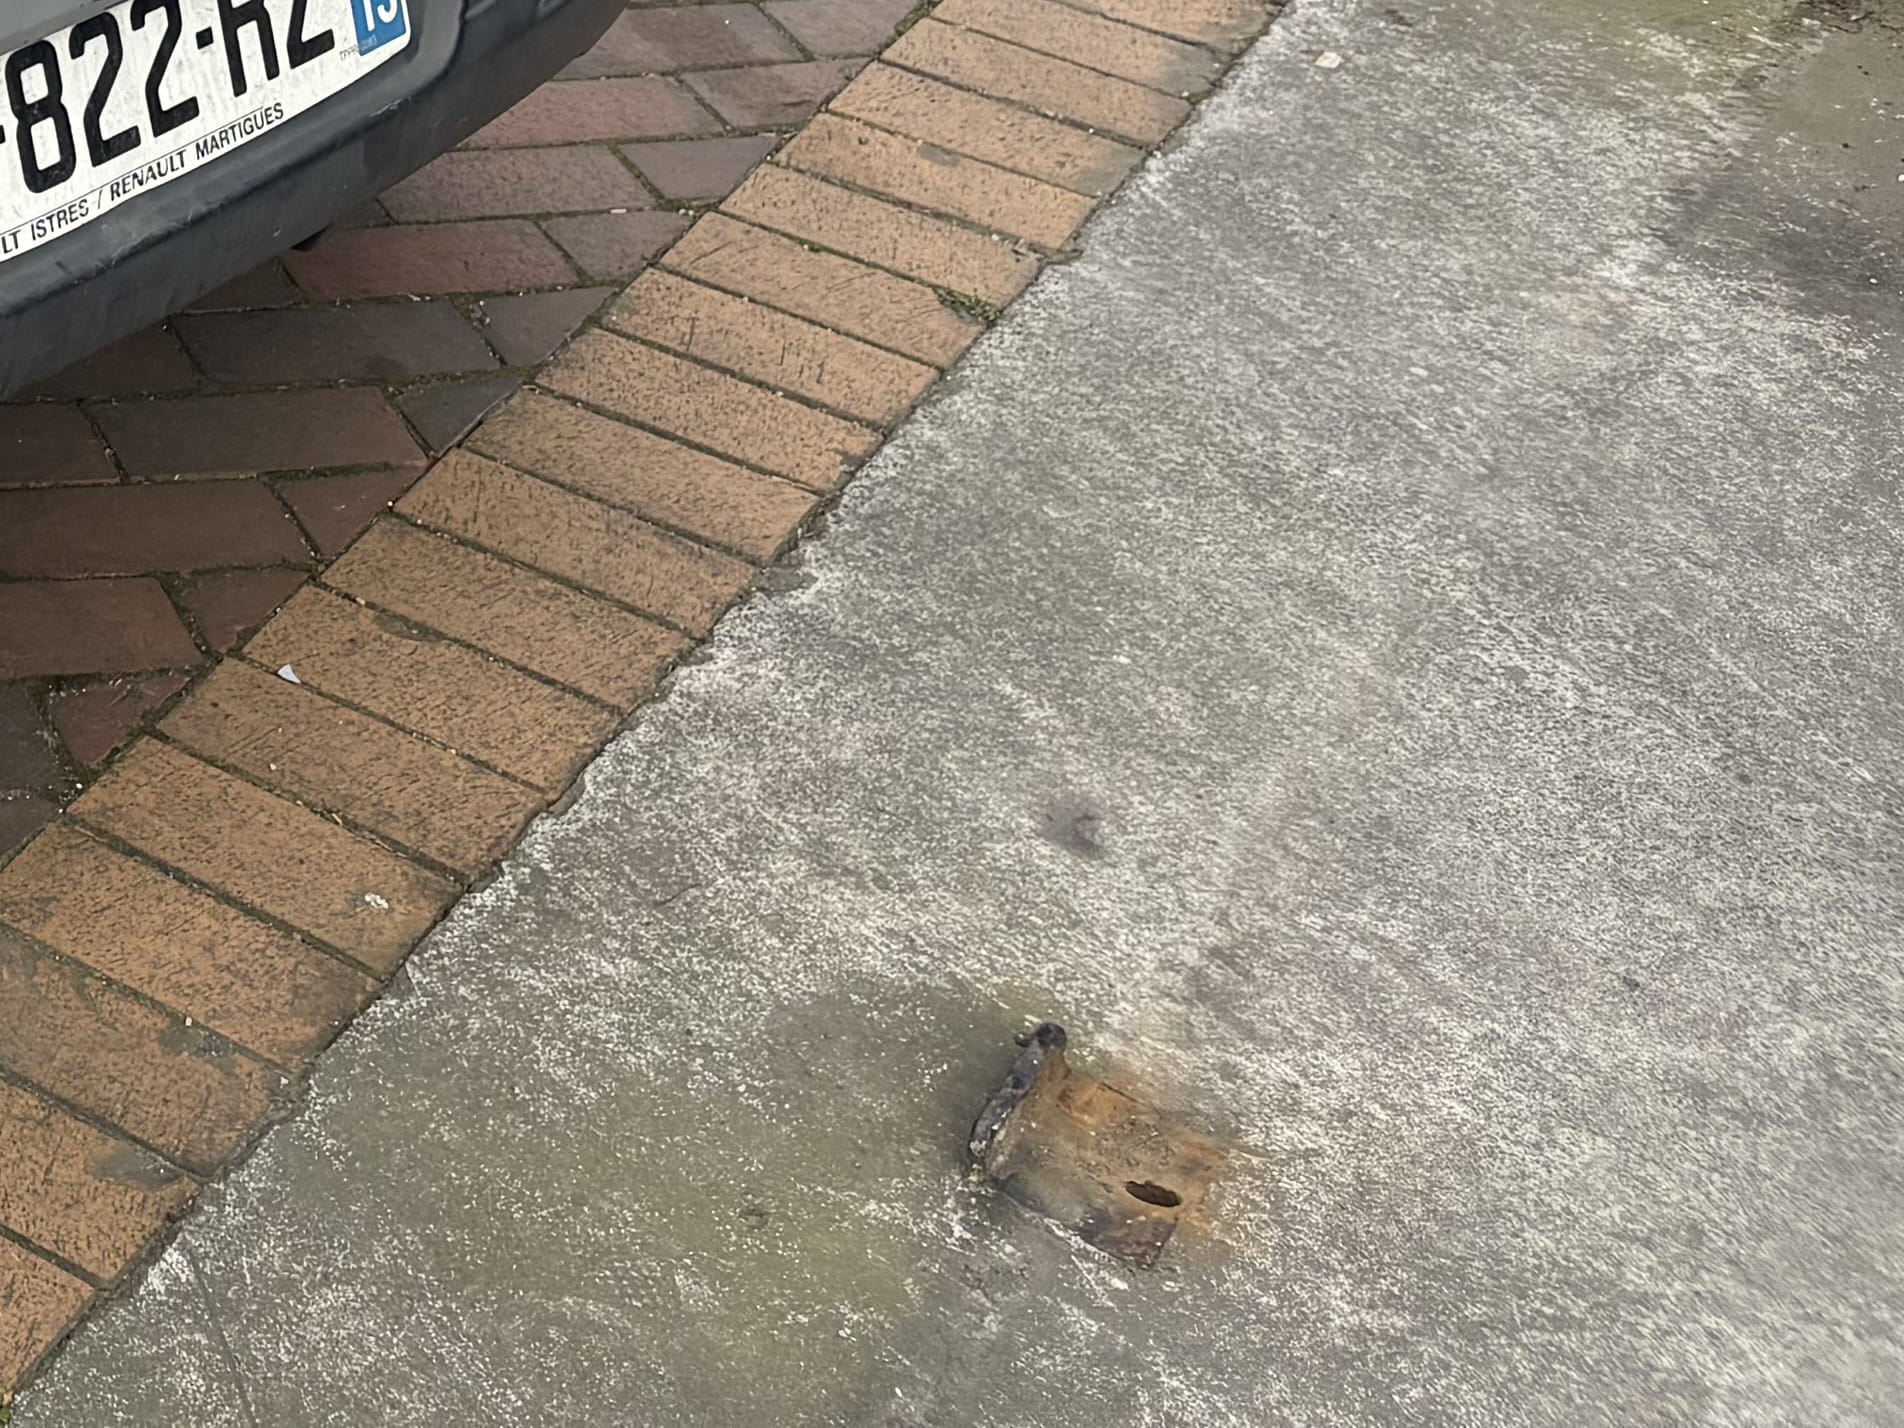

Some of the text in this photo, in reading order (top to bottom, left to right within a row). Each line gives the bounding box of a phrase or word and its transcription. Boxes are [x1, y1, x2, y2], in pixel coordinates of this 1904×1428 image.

[31, 199, 89, 241] ISTRES
[111, 149, 186, 201] RENAULT
[196, 102, 284, 160] MARTIGUES
